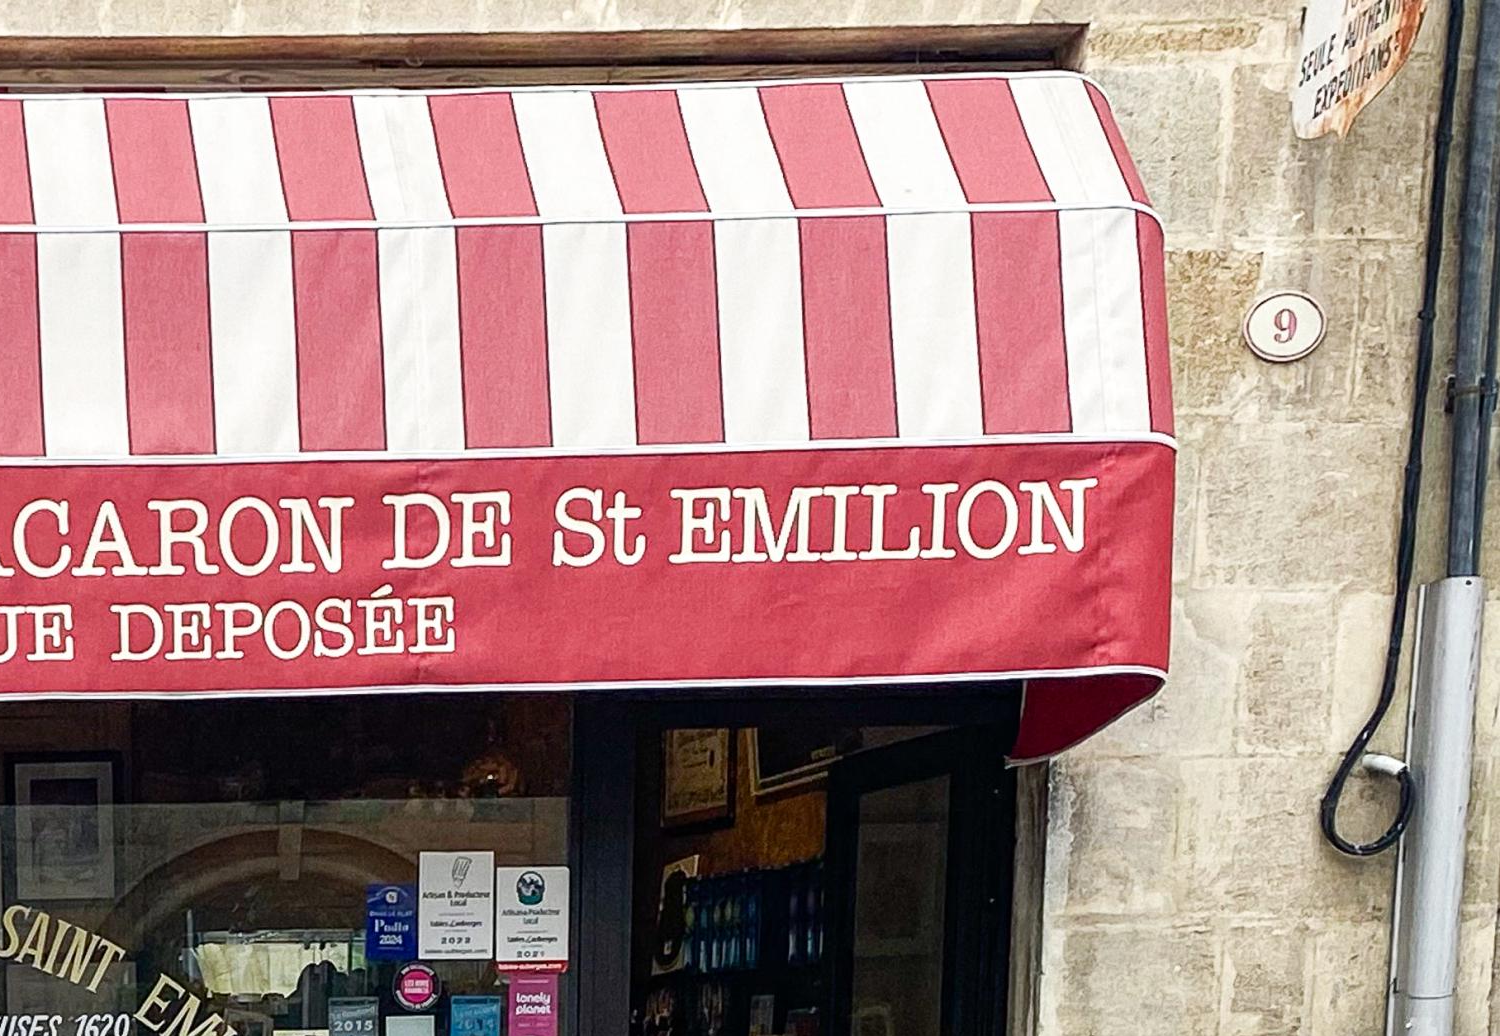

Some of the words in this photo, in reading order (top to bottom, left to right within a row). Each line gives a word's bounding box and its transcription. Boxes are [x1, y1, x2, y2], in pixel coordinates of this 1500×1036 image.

[1299, 33, 1337, 87] SEULE
[1273, 308, 1298, 343] 9
[382, 491, 512, 570] DE
[552, 487, 648, 567] St
[669, 478, 1099, 565] EMILION
[110, 584, 457, 662] DEPOSÉE
[379, 934, 403, 945] 2024
[515, 992, 552, 1006] lonely
[515, 1003, 552, 1015] planet
[333, 1019, 374, 1032] 2015
